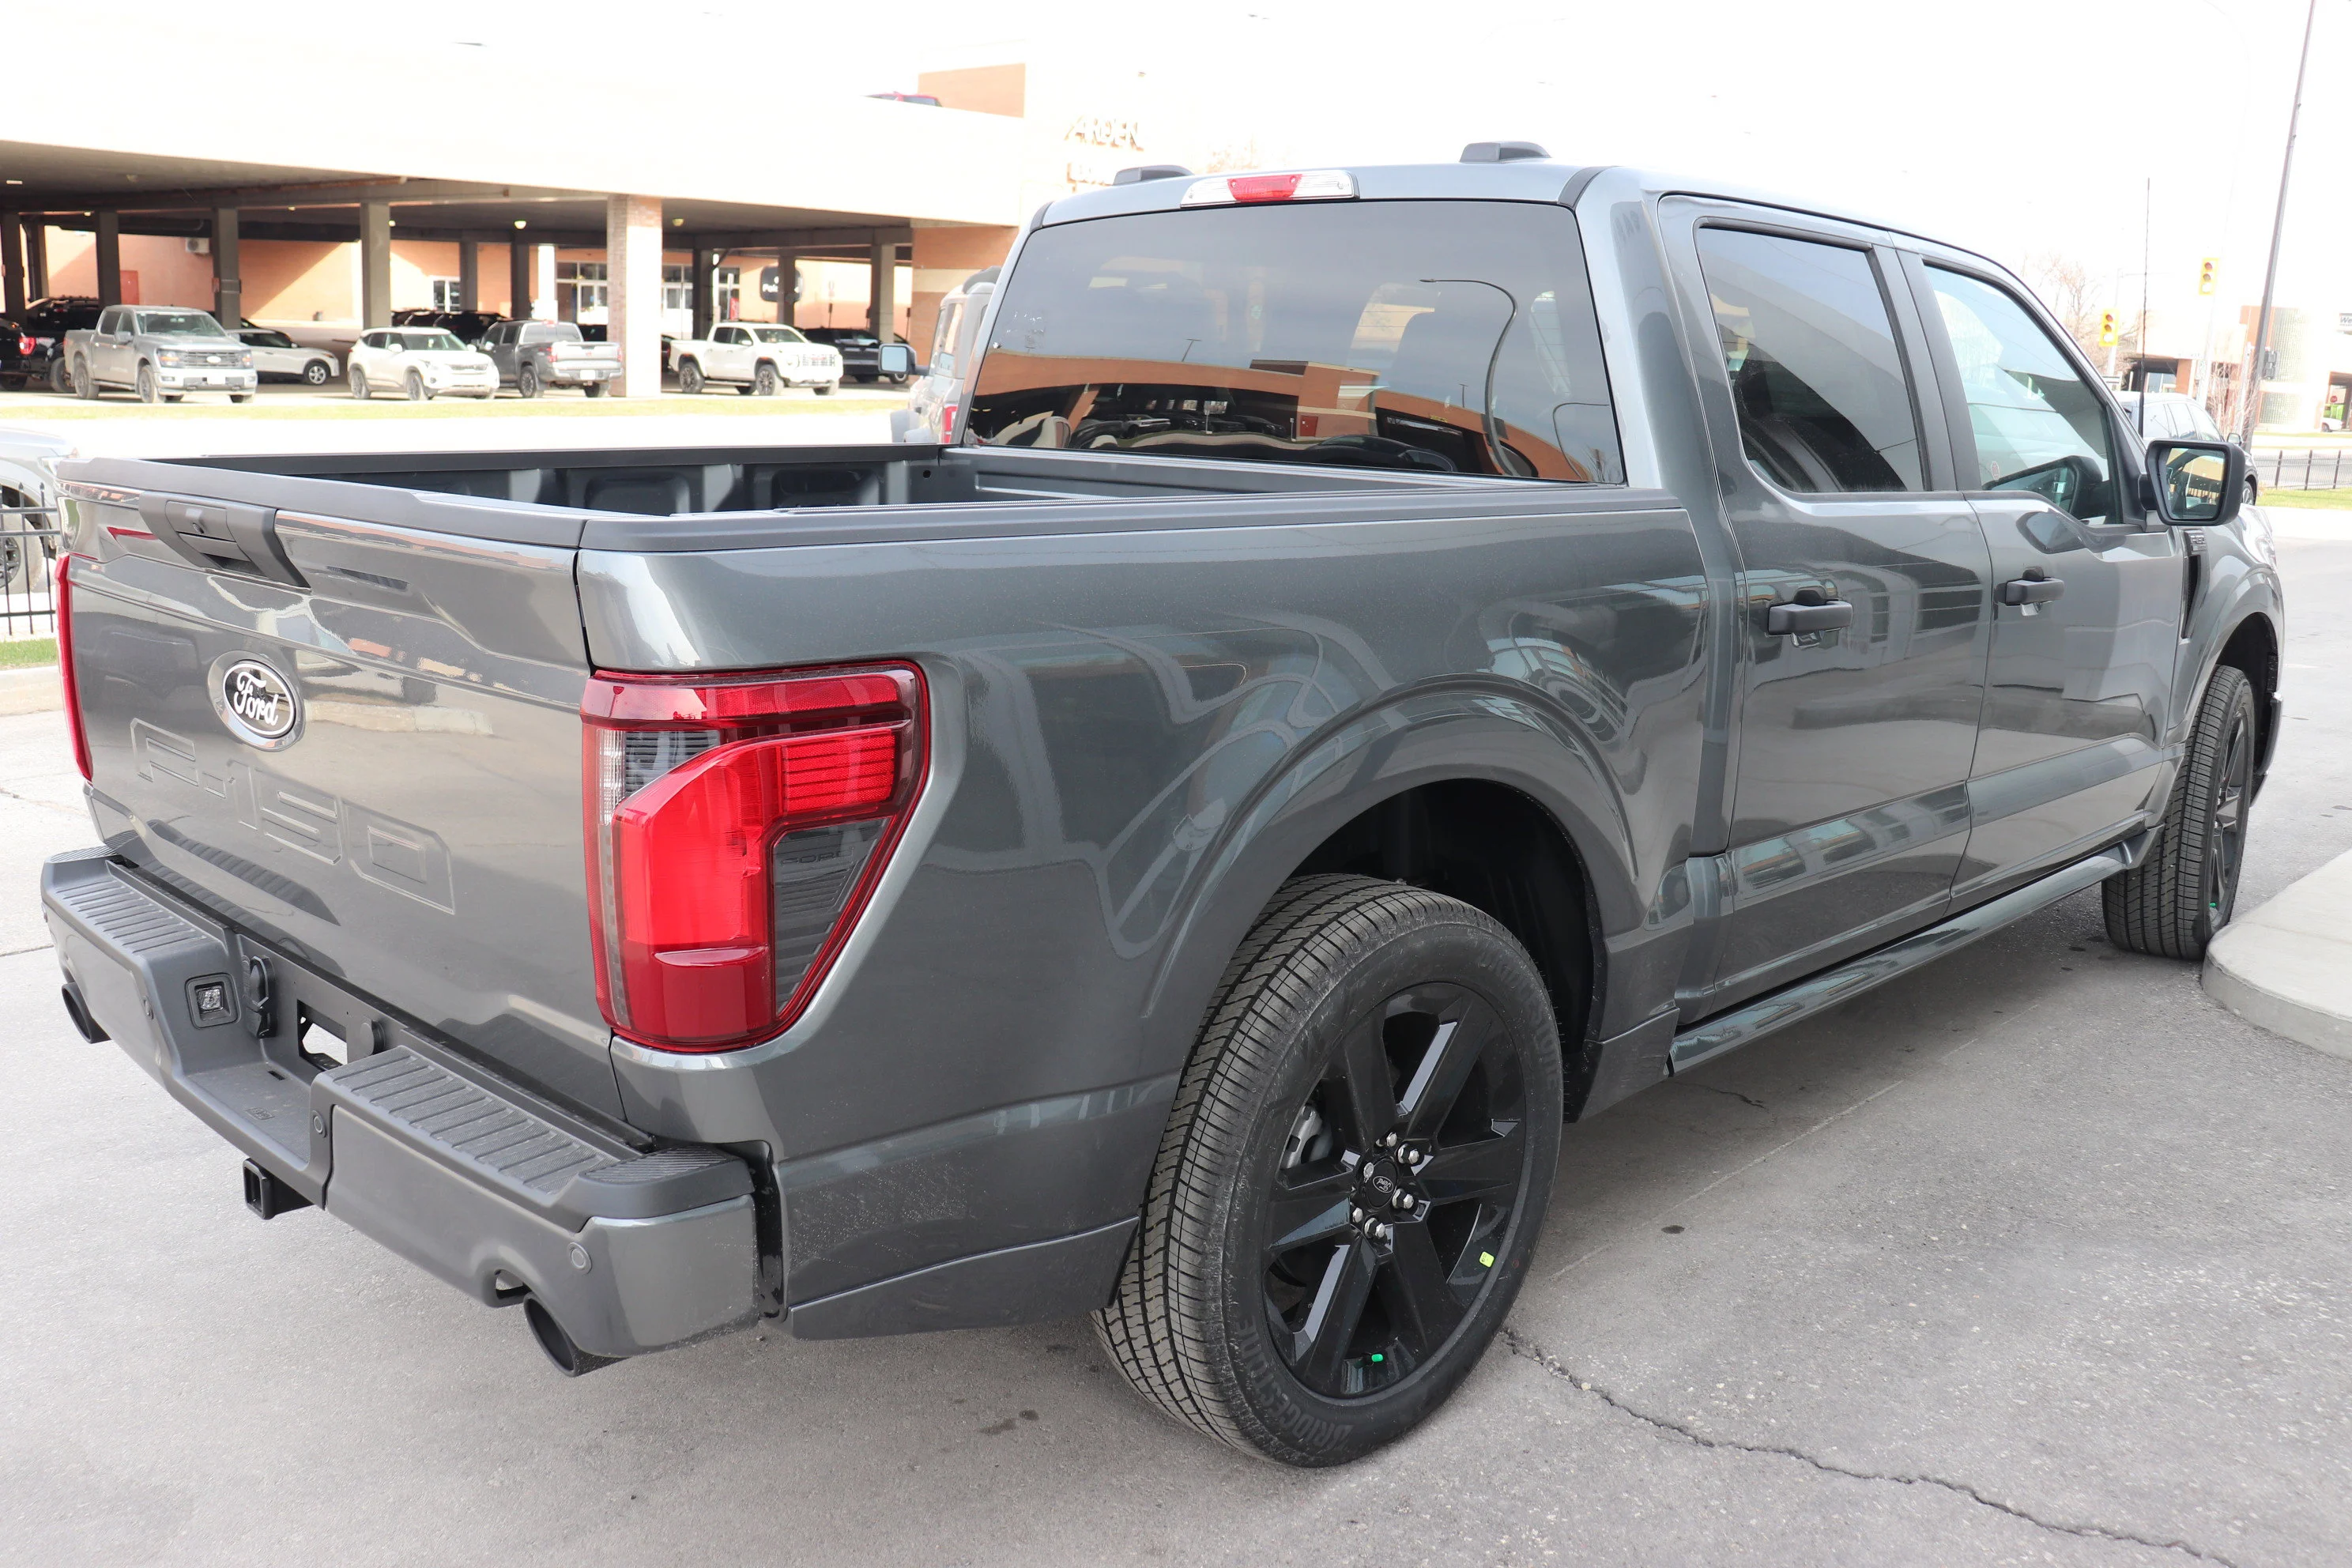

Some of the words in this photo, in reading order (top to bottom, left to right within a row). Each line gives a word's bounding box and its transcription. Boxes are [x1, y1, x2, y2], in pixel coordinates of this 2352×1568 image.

[233, 671, 279, 726] Ford
[130, 717, 455, 915] F-150
[780, 847, 854, 865] FORD
[1376, 1178, 1392, 1192] Ford
[1236, 1313, 1355, 1452] BRIDGESTONE
